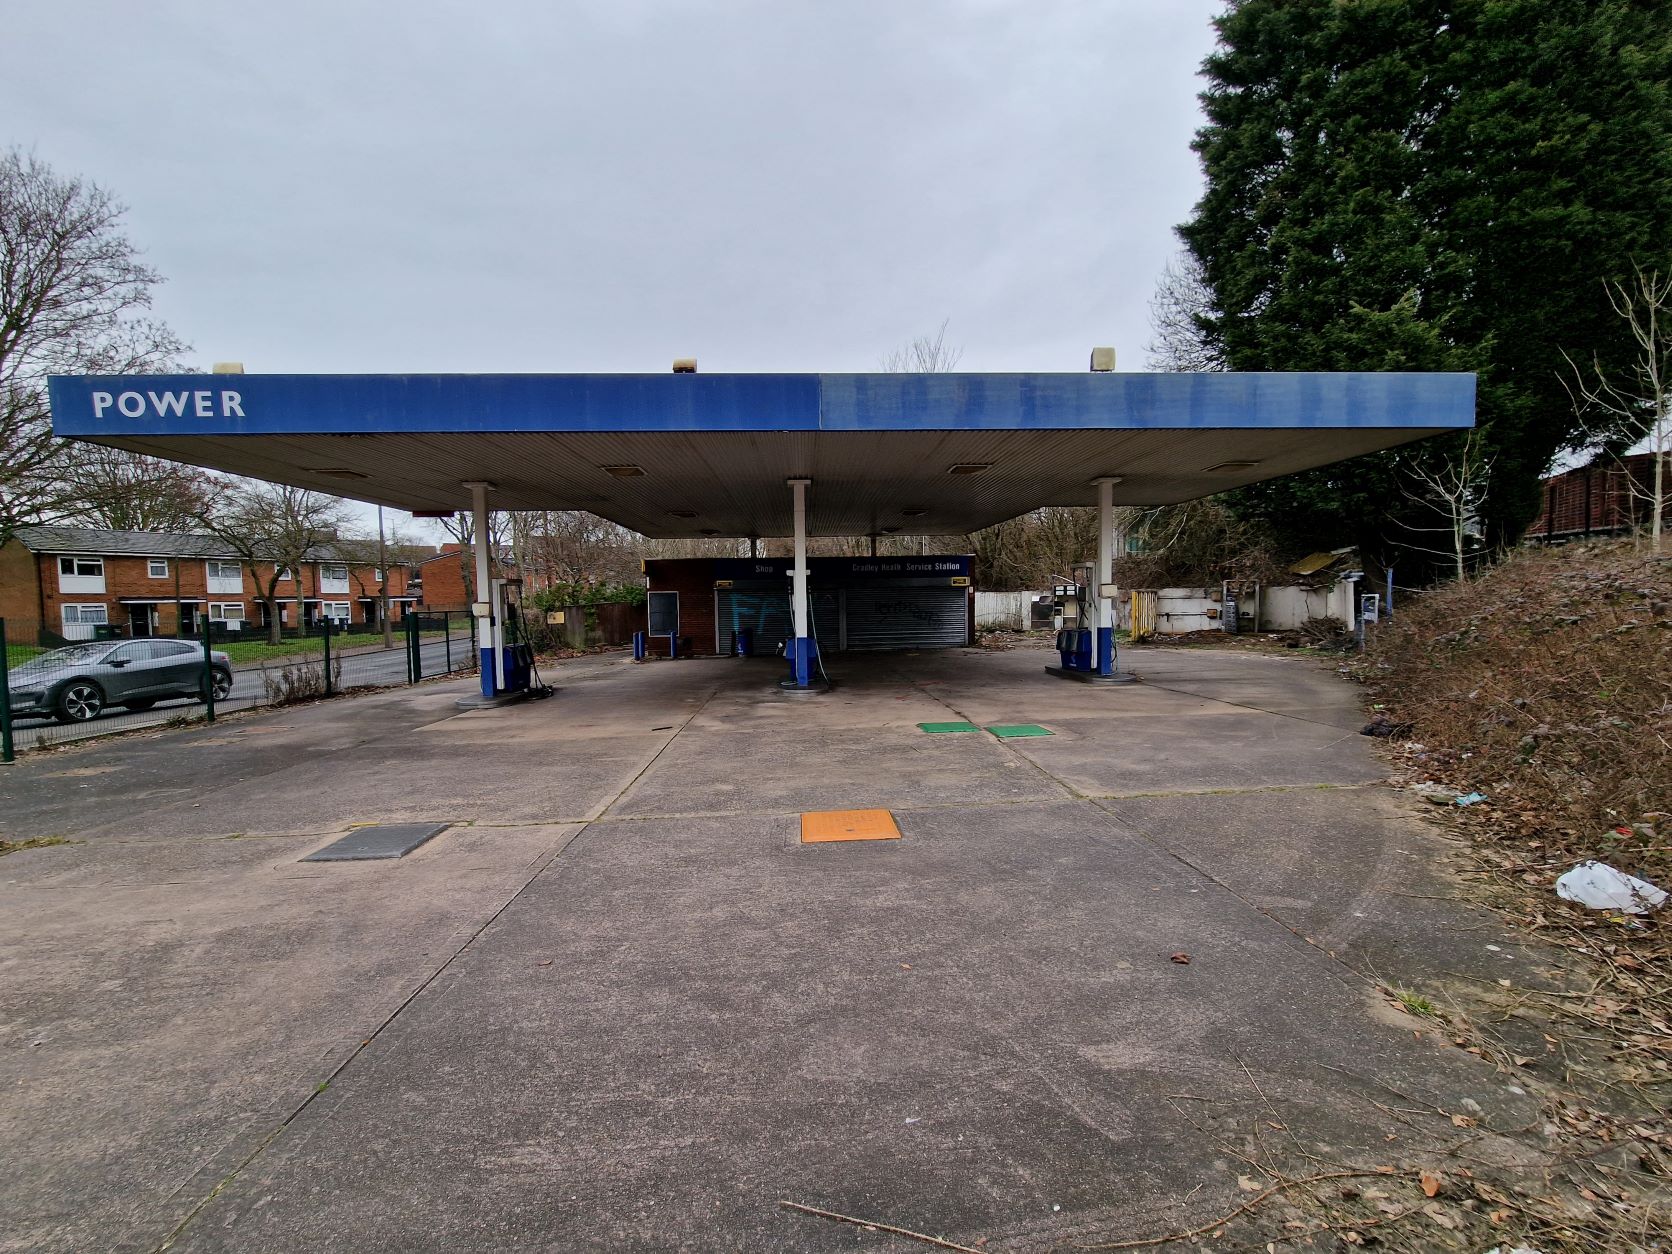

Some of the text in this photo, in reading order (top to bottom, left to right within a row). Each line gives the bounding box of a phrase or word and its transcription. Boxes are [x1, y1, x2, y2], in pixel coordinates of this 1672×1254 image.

[92, 390, 246, 418] POWER
[755, 564, 774, 573] Shop
[852, 562, 960, 572] Cradley Heath Service Station
